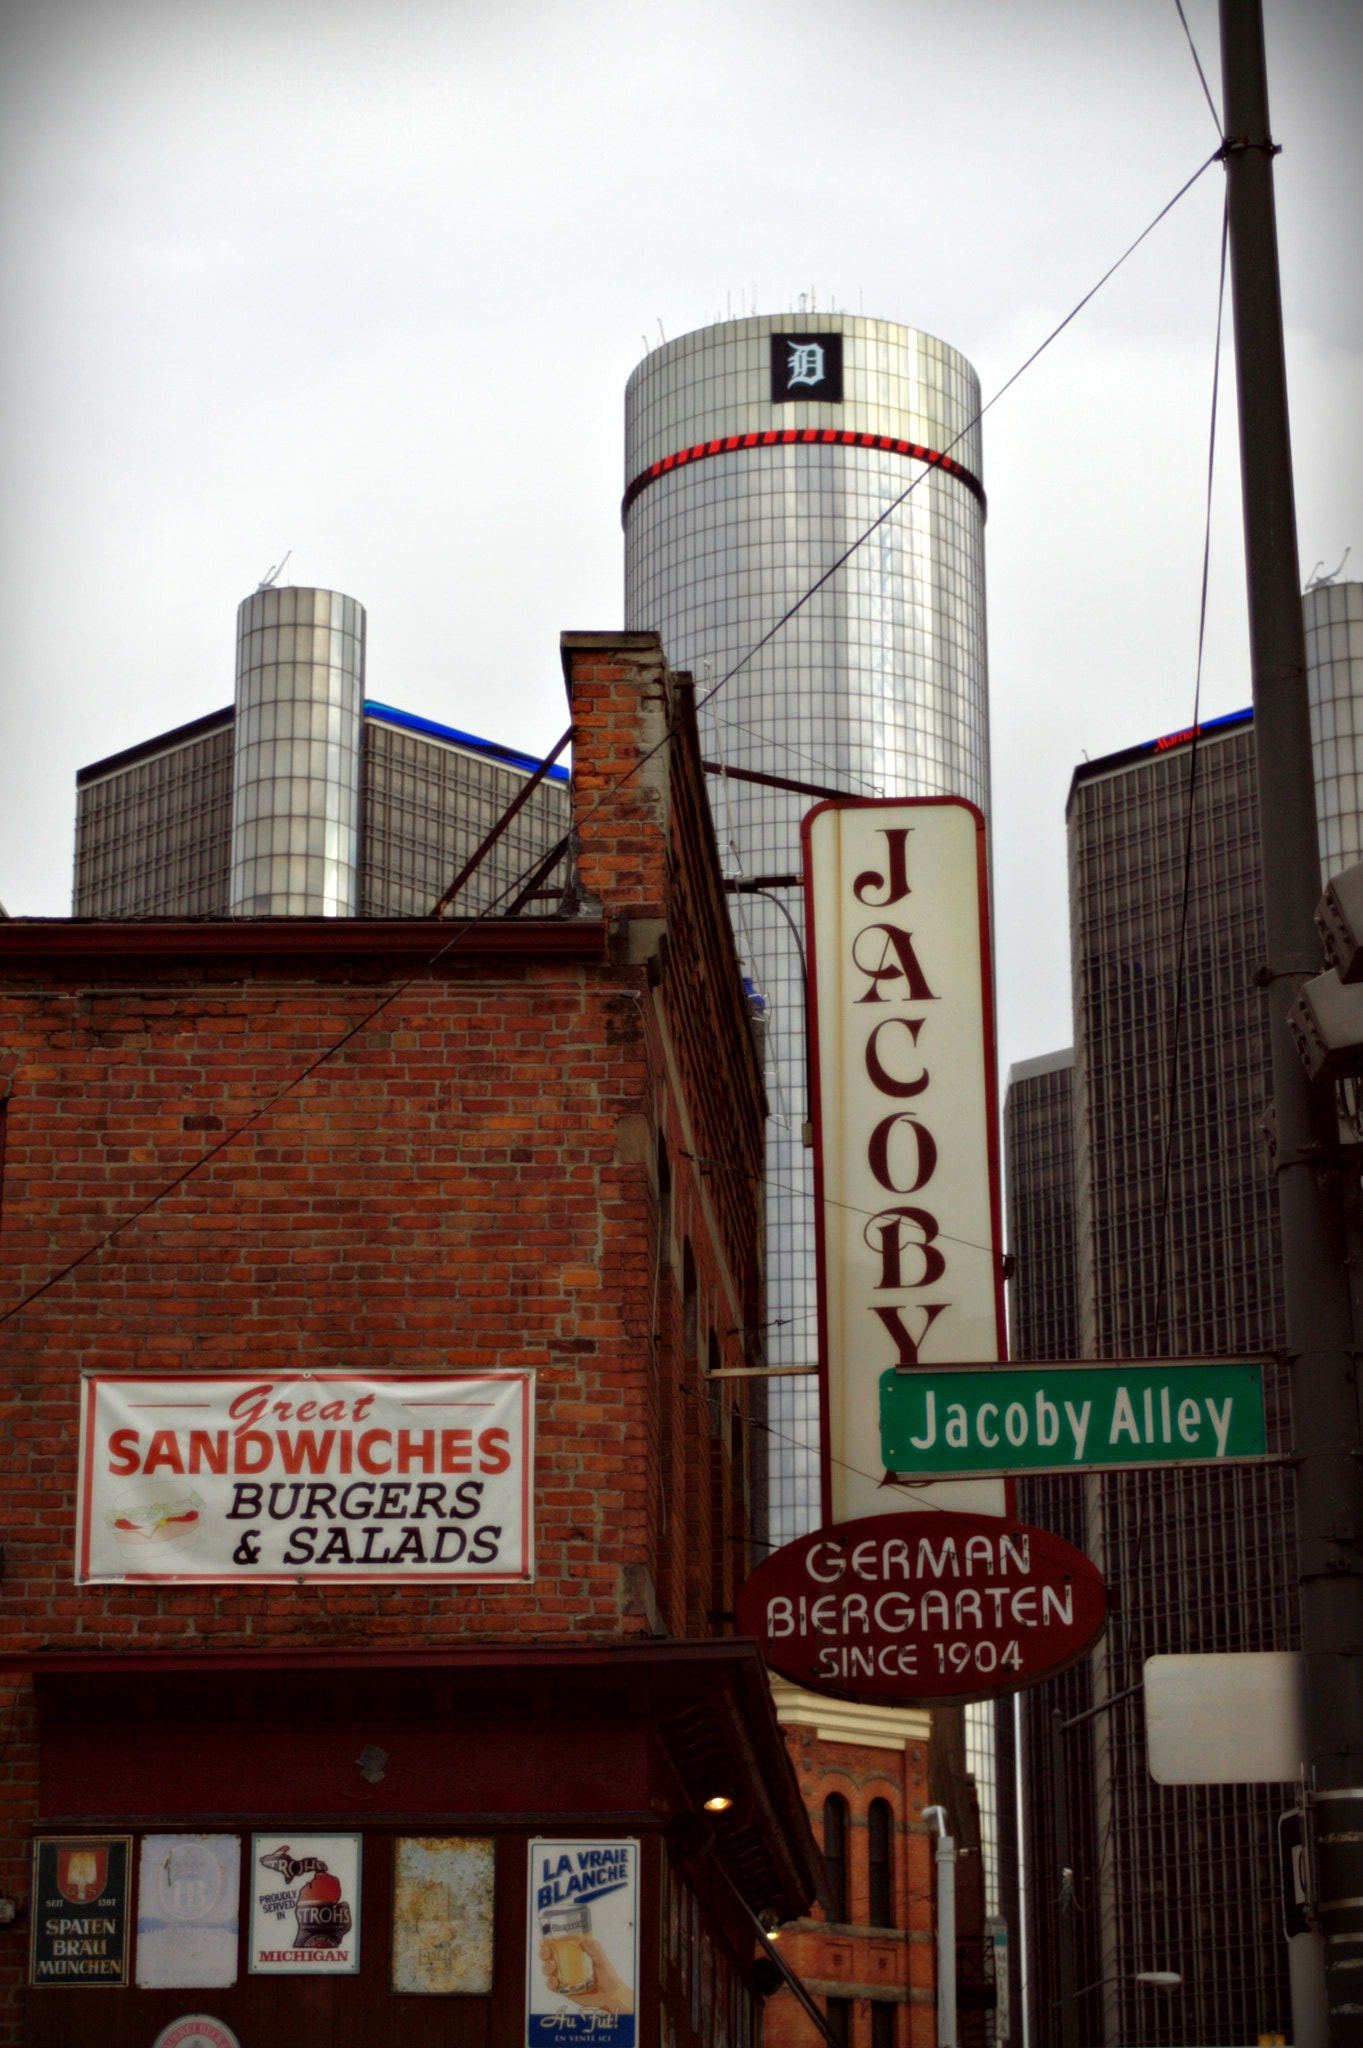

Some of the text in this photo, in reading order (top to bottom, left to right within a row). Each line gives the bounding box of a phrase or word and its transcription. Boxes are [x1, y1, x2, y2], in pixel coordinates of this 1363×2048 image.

[852, 827, 952, 1364] JACOBY
[228, 1384, 376, 1437] Great
[909, 1385, 1234, 1461] Jacoby Alley
[107, 1427, 512, 1476] SANDWICHES
[226, 1481, 484, 1520] BURGERS
[232, 1526, 503, 1565] & SALADS
[805, 1533, 1031, 1582] GERMAN
[767, 1584, 1074, 1637] BIERGARTEN
[819, 1640, 1024, 1679] SINCE 1904
[543, 1848, 629, 1882] LA VRAIE
[259, 1889, 297, 1905] PROUDLY
[537, 1864, 629, 1910] BLANCHE
[46, 1918, 116, 1935] SPATEN
[263, 1900, 296, 1914] SERVED
[276, 1911, 286, 1922] IN
[52, 1938, 108, 1956] BRÄU
[258, 1949, 350, 1963] MICHIGAN
[540, 2006, 577, 2030] Au
